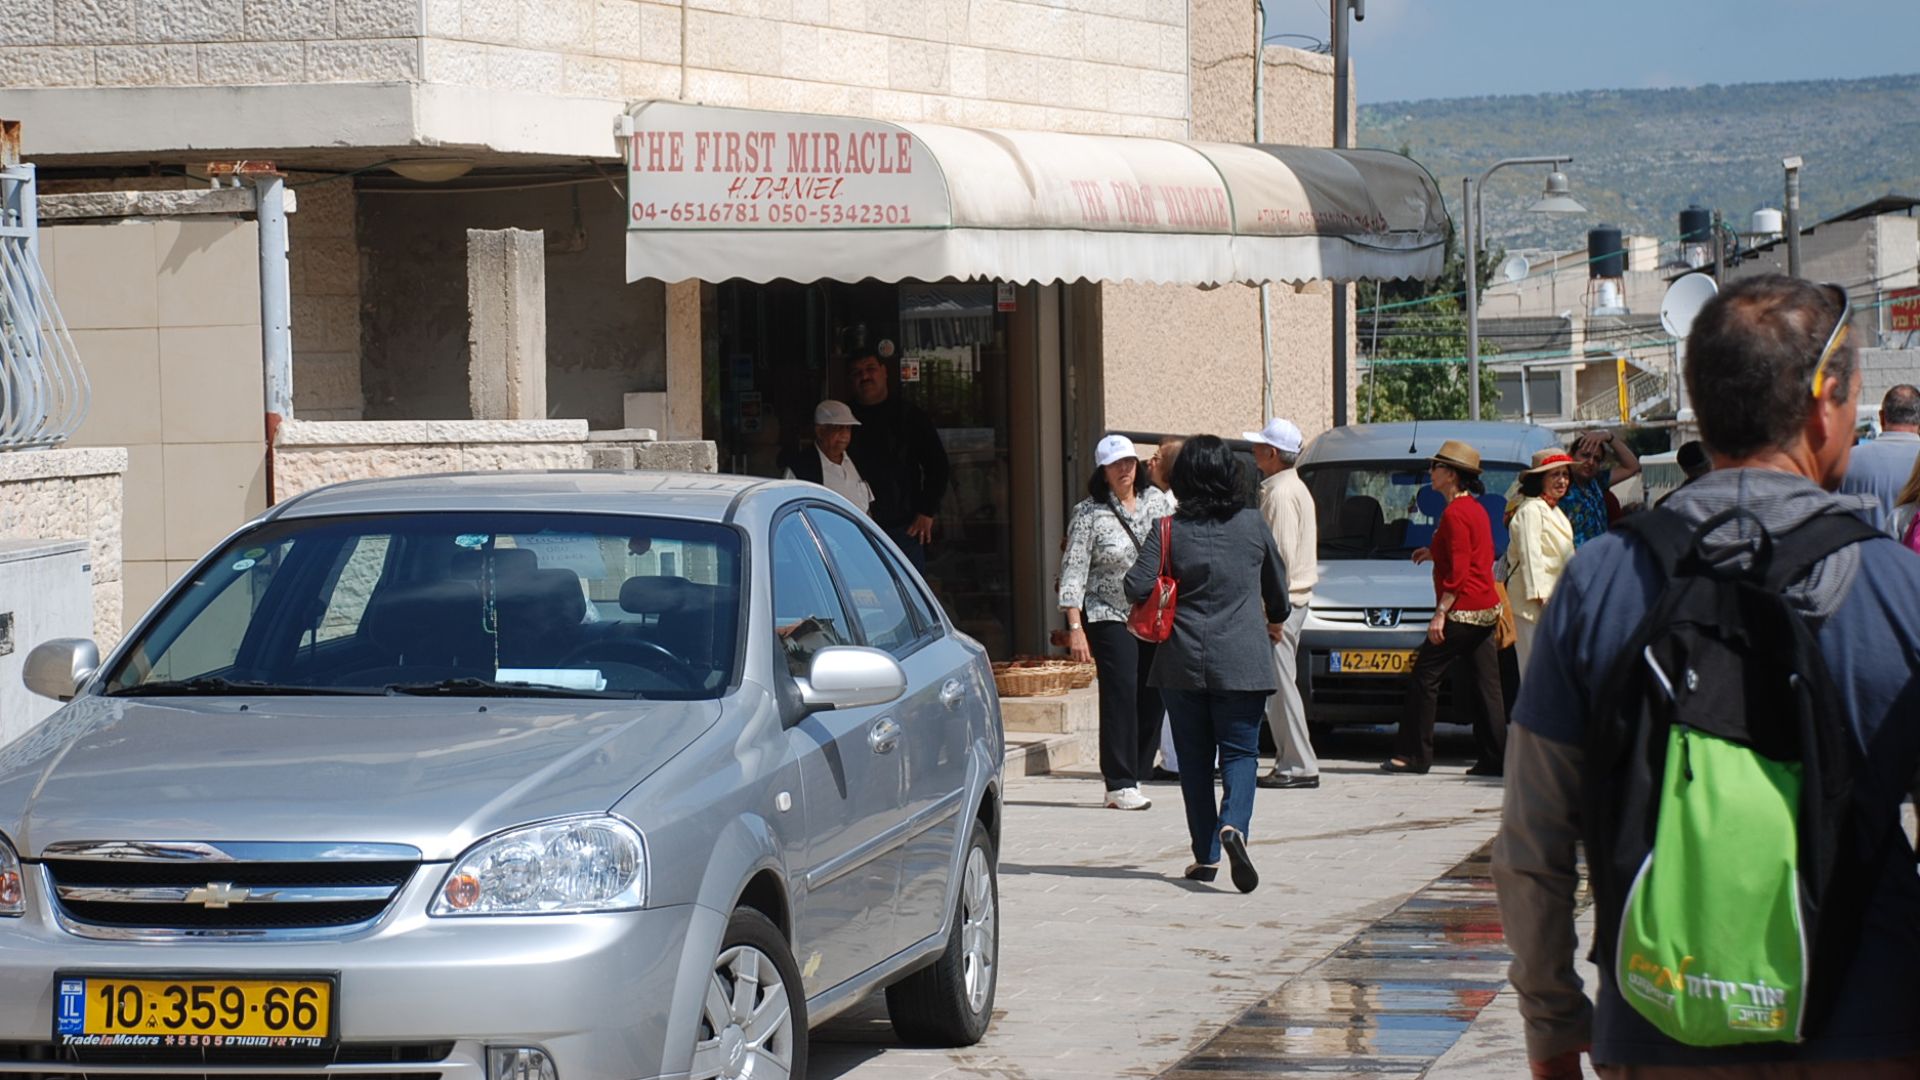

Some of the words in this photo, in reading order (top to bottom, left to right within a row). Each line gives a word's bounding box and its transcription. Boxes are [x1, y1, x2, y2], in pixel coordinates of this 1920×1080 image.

[631, 131, 684, 173] THE
[694, 131, 776, 173] FIRST
[787, 132, 913, 174] MIRACLE
[728, 176, 845, 201] H.DANIEL
[631, 202, 760, 223] 04-6516781
[768, 203, 912, 224] 050-5342301
[63, 995, 80, 1017] IL
[61, 1033, 160, 1046] TradeInMotors
